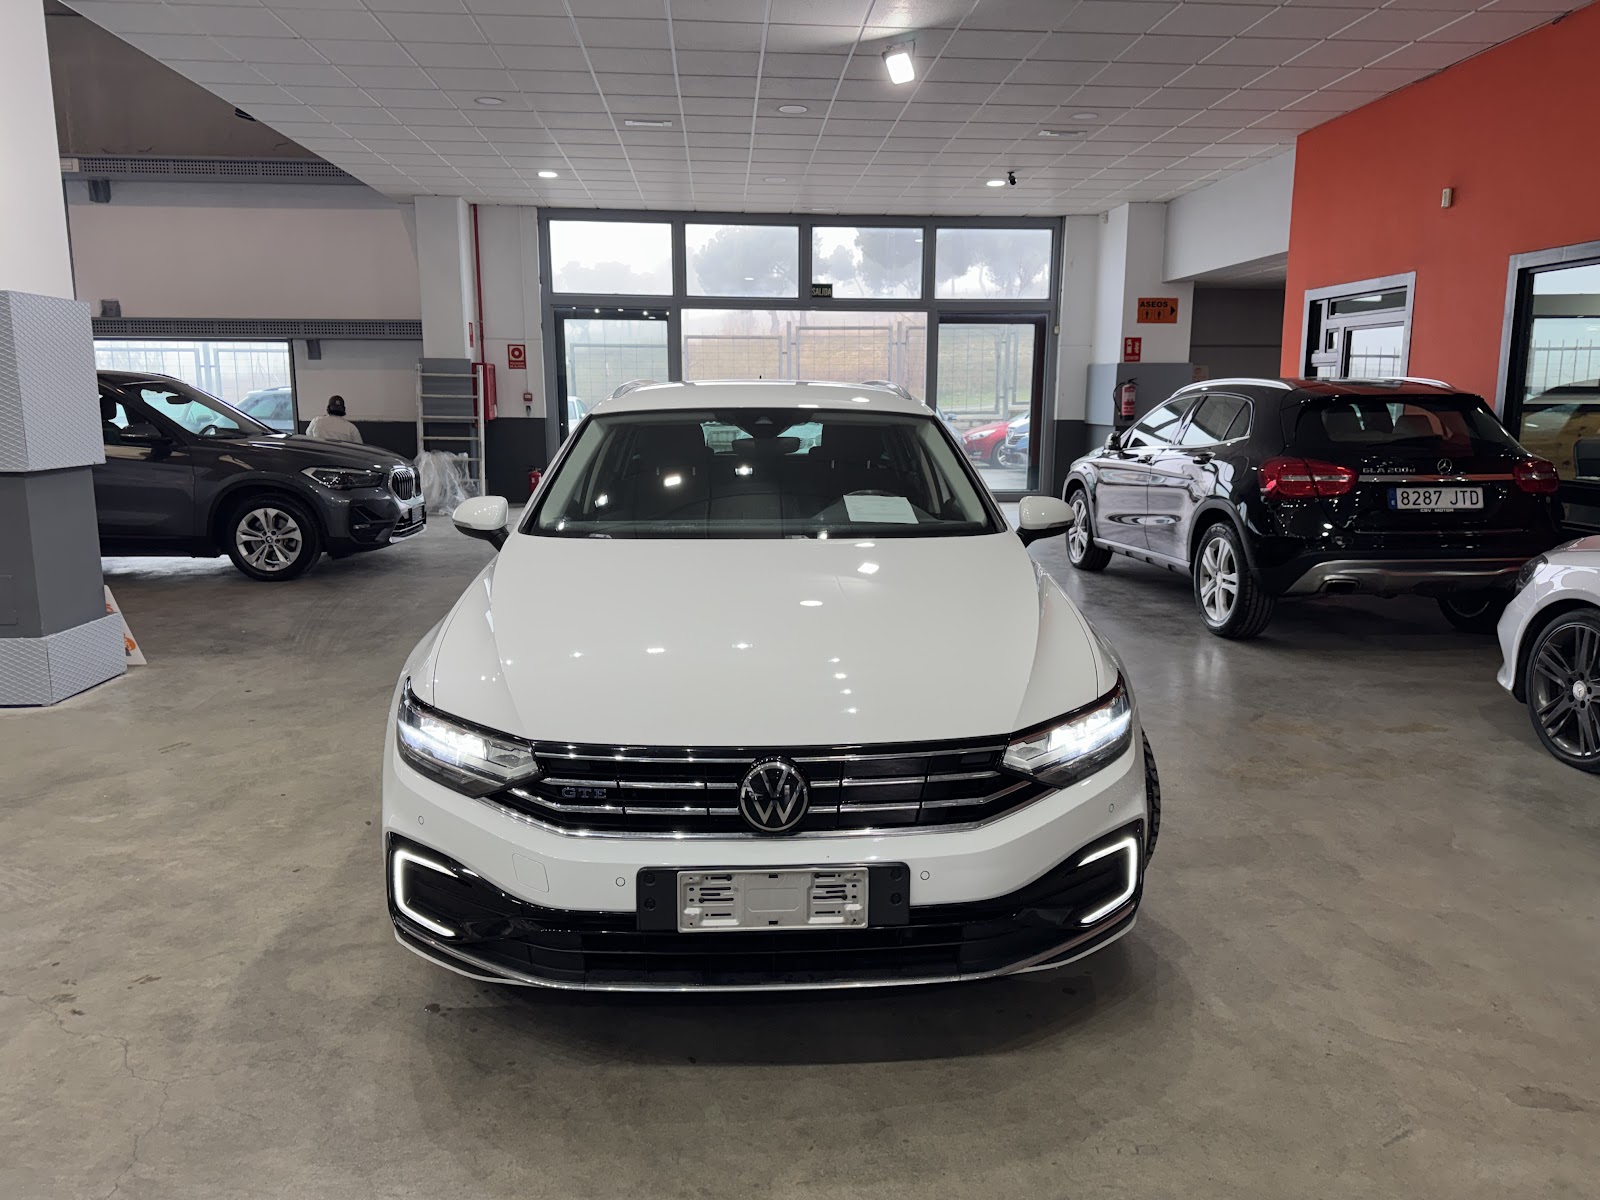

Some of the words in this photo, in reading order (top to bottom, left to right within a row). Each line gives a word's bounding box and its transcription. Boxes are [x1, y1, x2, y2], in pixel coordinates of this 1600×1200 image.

[1400, 490, 1442, 506] 8287
[1449, 490, 1479, 505] JTD
[561, 786, 607, 799] GTE
